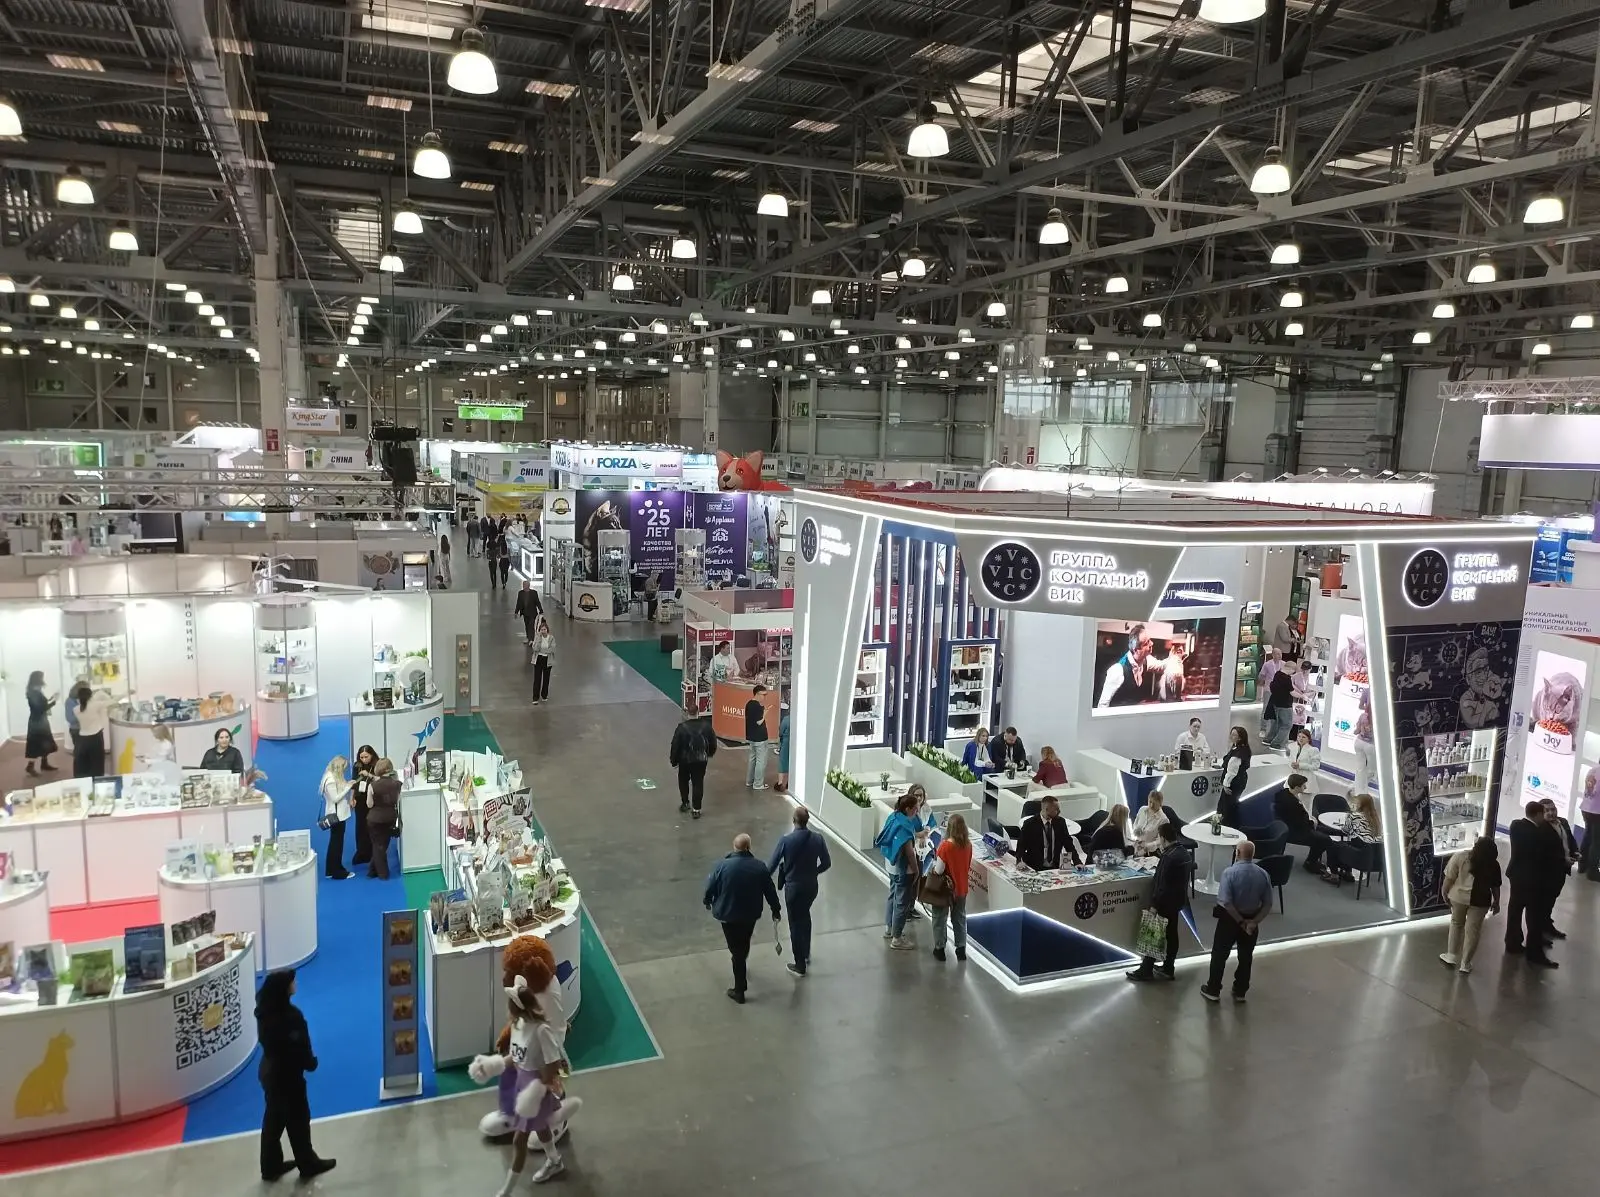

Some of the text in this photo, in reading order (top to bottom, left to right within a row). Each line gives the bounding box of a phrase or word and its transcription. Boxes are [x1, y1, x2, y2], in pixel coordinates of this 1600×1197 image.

[292, 411, 327, 422] KingStar
[597, 457, 637, 469] FORZA
[519, 467, 544, 477] CHINA
[647, 508, 671, 526] 25
[645, 526, 670, 538] ЛЕТ
[1052, 552, 1116, 569] ГРУППА
[1051, 571, 1148, 589] КОМПАНИЙ
[1050, 588, 1083, 602] ВИК
[1524, 611, 1569, 619] УНИКАЛЬНЫЕ
[1522, 623, 1564, 631] КОМПЛЕКСЫ
[1523, 617, 1589, 627] ФУНКЦИОНАЛЬНЫЕ
[722, 705, 745, 715] МИРАТ
[1543, 733, 1561, 748] Joy
[1102, 889, 1128, 898] ГРУППА
